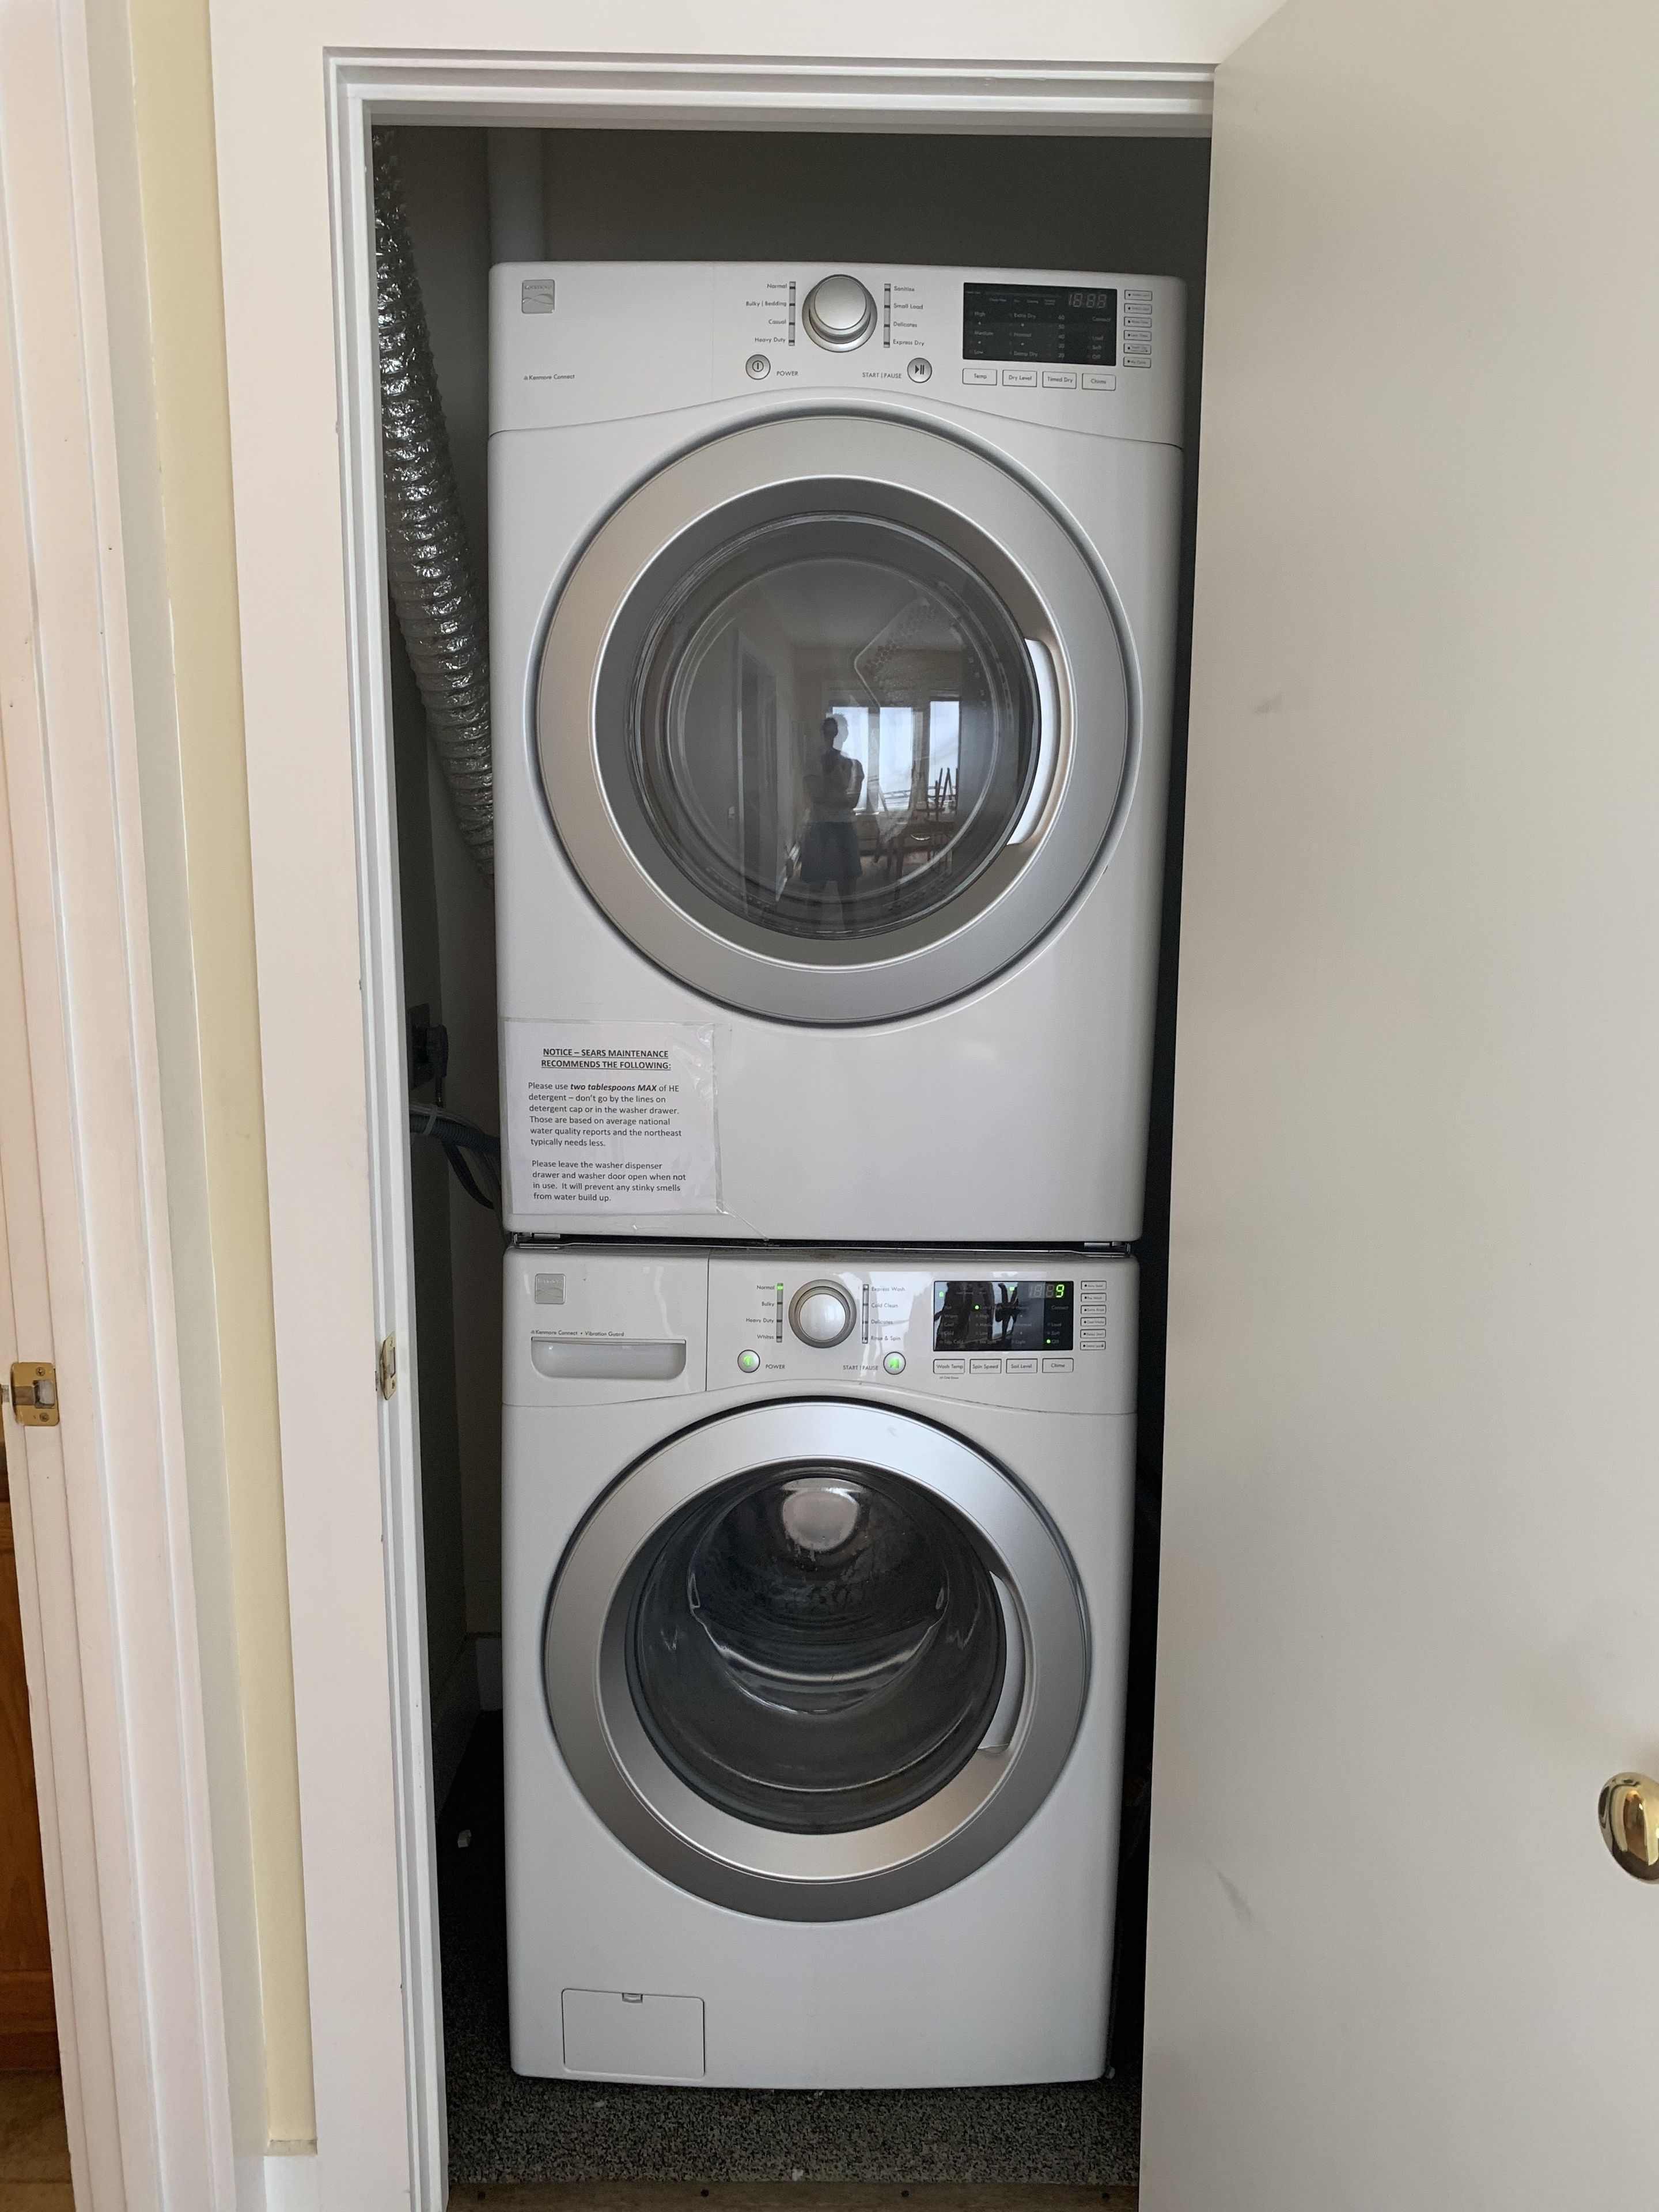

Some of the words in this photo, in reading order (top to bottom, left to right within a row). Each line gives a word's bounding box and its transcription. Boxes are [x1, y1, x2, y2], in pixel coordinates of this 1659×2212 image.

[608, 1050, 668, 1058] MAINTENANCE
[588, 1084, 635, 1092] tablespoons
[529, 1094, 566, 1102] detergent
[610, 1095, 619, 1103] by
[529, 1105, 567, 1113] detergent
[555, 1128, 581, 1136] quality
[531, 1139, 562, 1147] typically
[625, 1162, 662, 1170] dispenser
[632, 1184, 654, 1192] stinky
